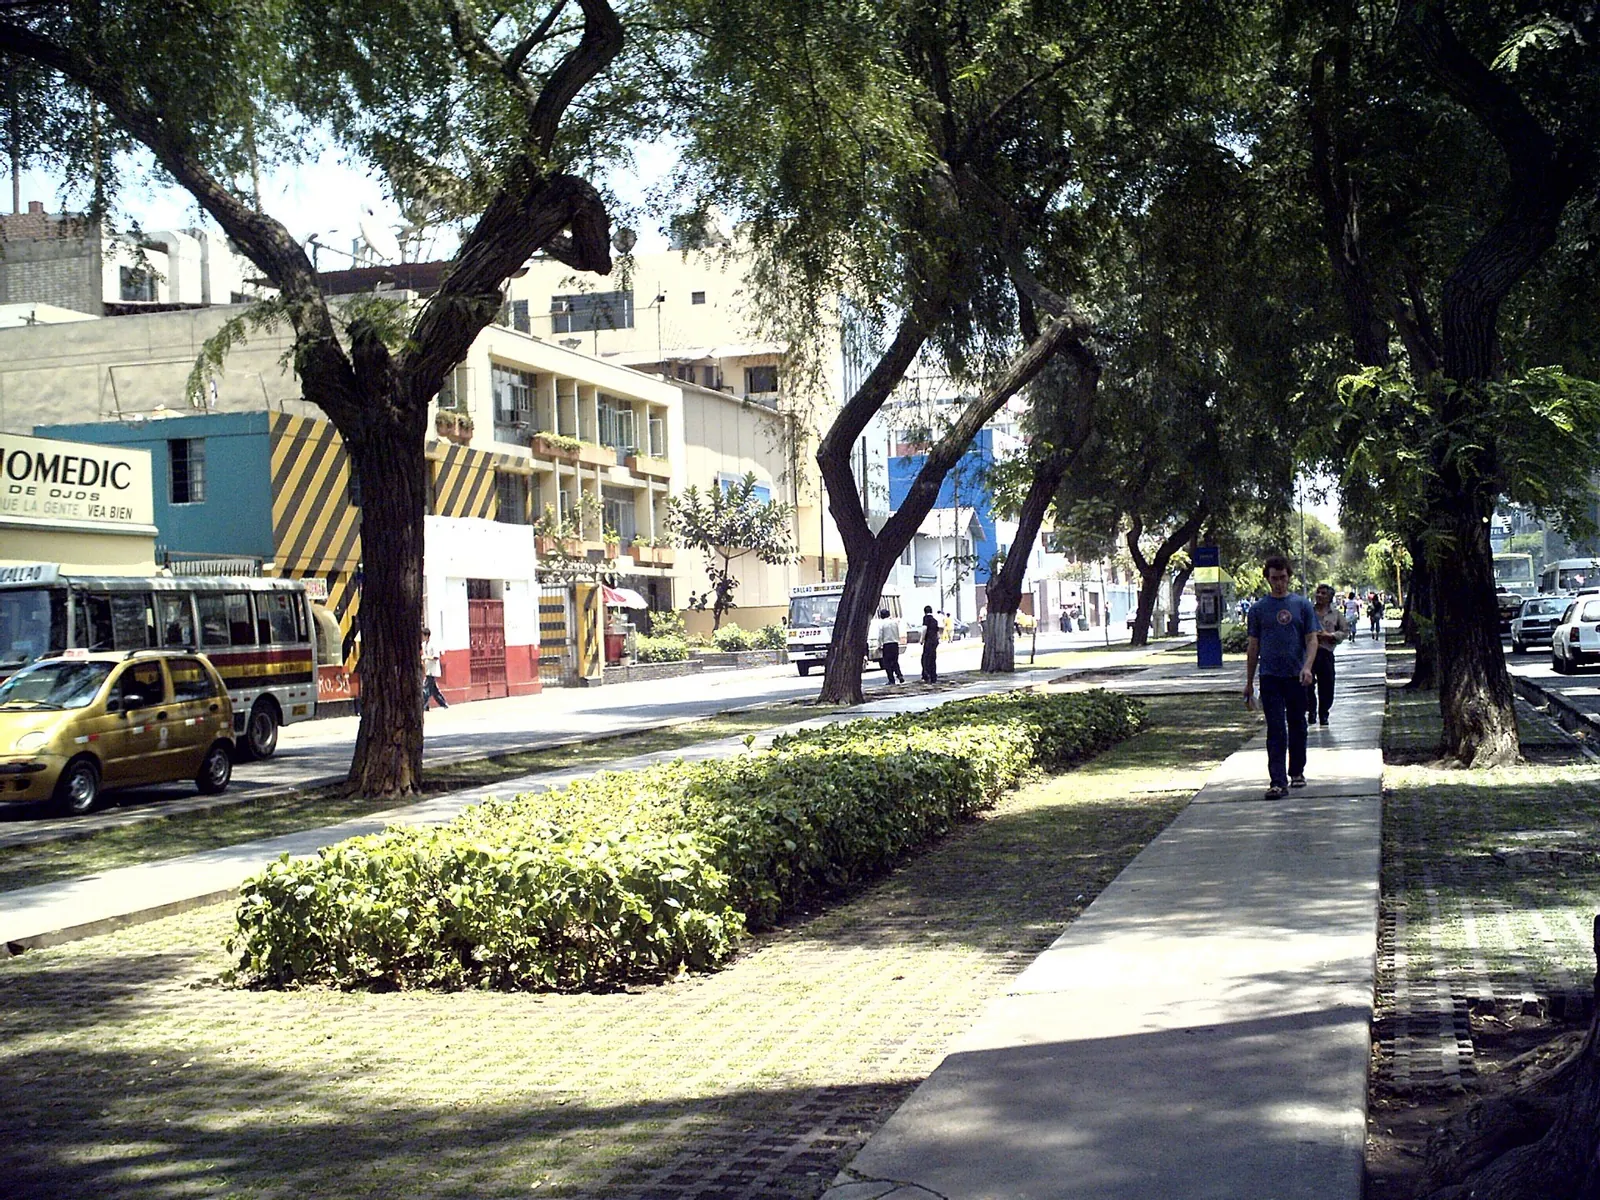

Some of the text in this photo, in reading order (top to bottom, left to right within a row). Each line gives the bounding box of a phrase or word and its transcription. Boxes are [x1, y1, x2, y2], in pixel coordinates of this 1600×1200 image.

[9, 484, 100, 502] DE OJOS
[0, 498, 18, 511] UE
[24, 500, 37, 511] LA
[88, 504, 106, 518] VEA
[110, 506, 133, 520] BIEN
